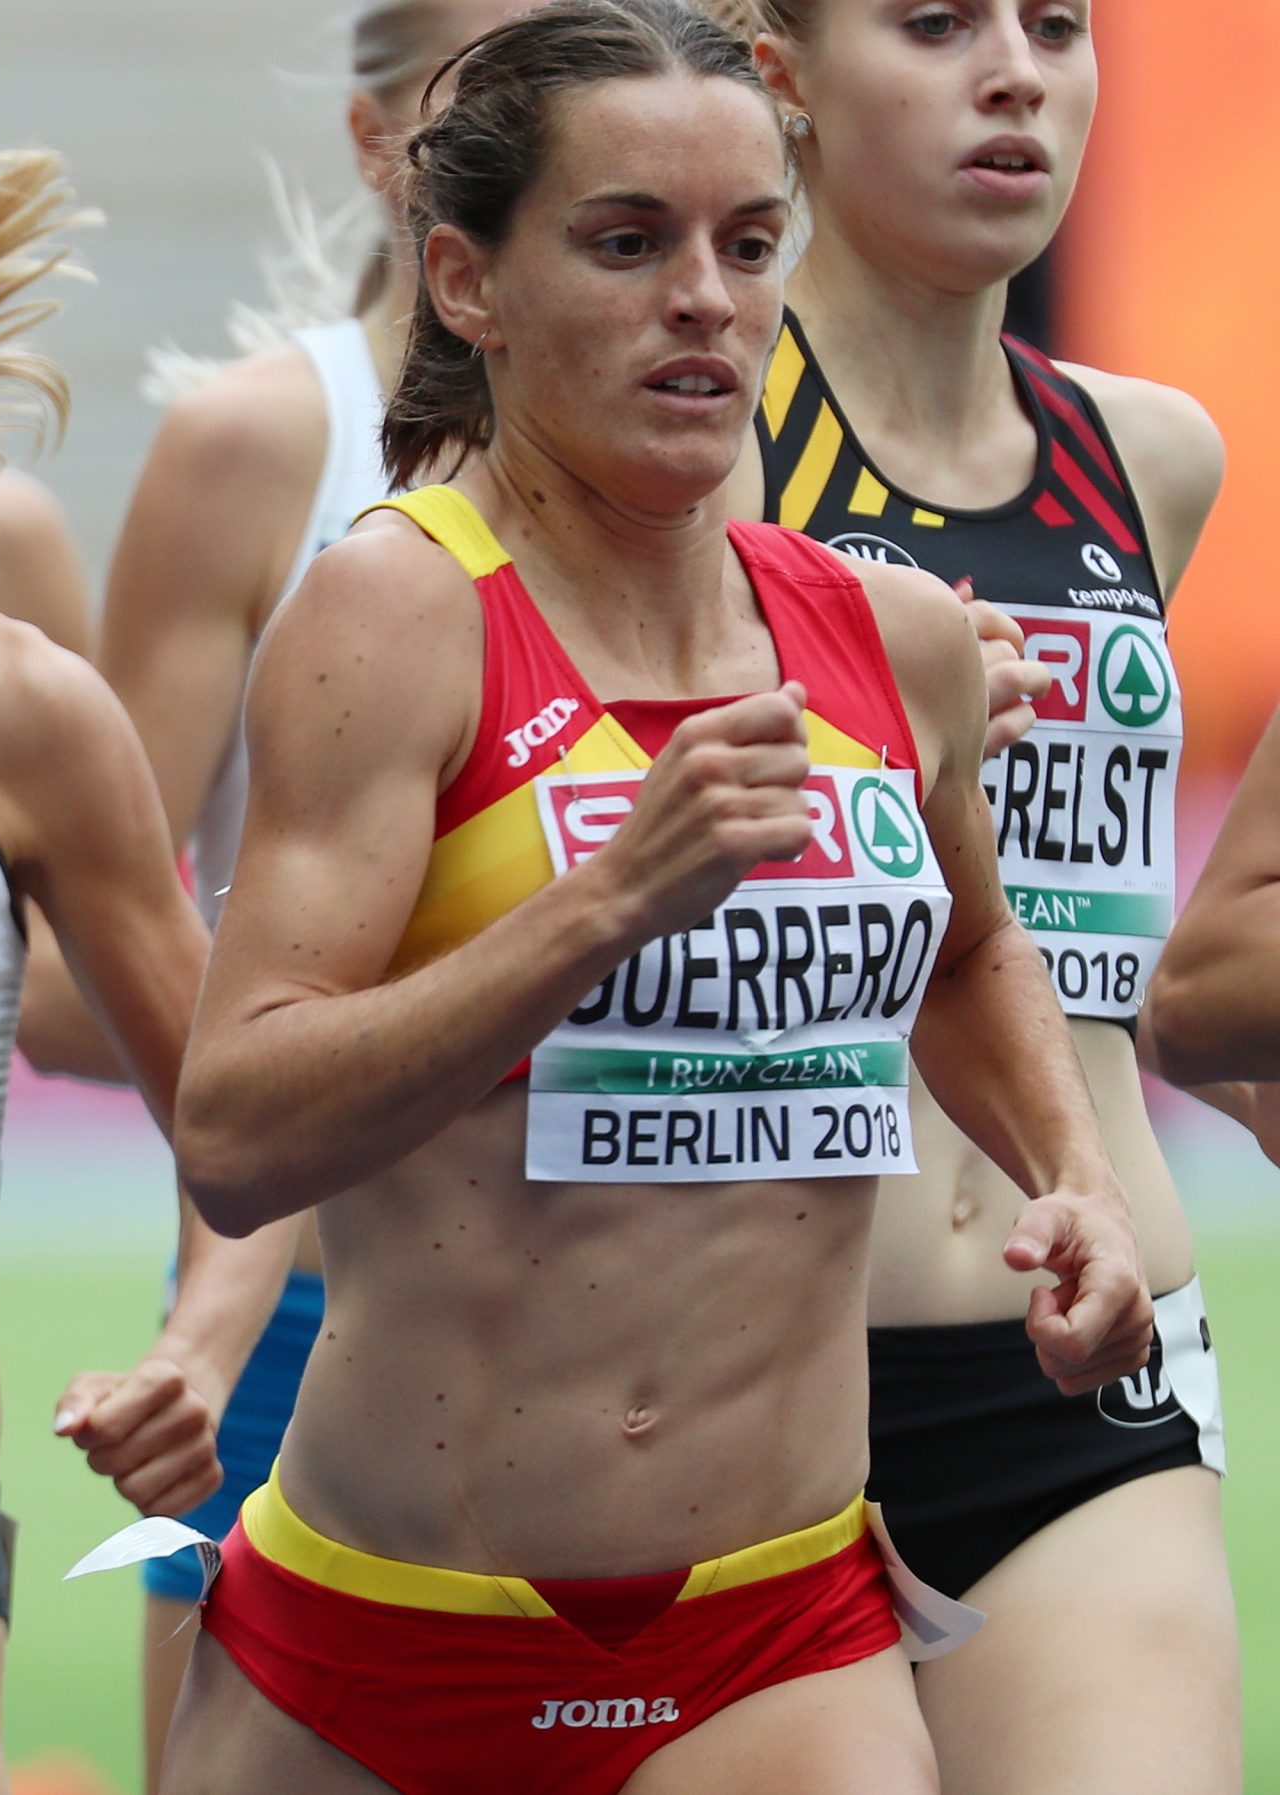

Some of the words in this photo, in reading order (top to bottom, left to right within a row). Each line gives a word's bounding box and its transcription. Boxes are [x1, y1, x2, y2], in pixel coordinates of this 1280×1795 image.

[647, 1057, 658, 1088] I
[671, 1058, 753, 1089] RUN
[582, 1105, 791, 1165] BERLIN
[812, 1103, 902, 1160] 2018
